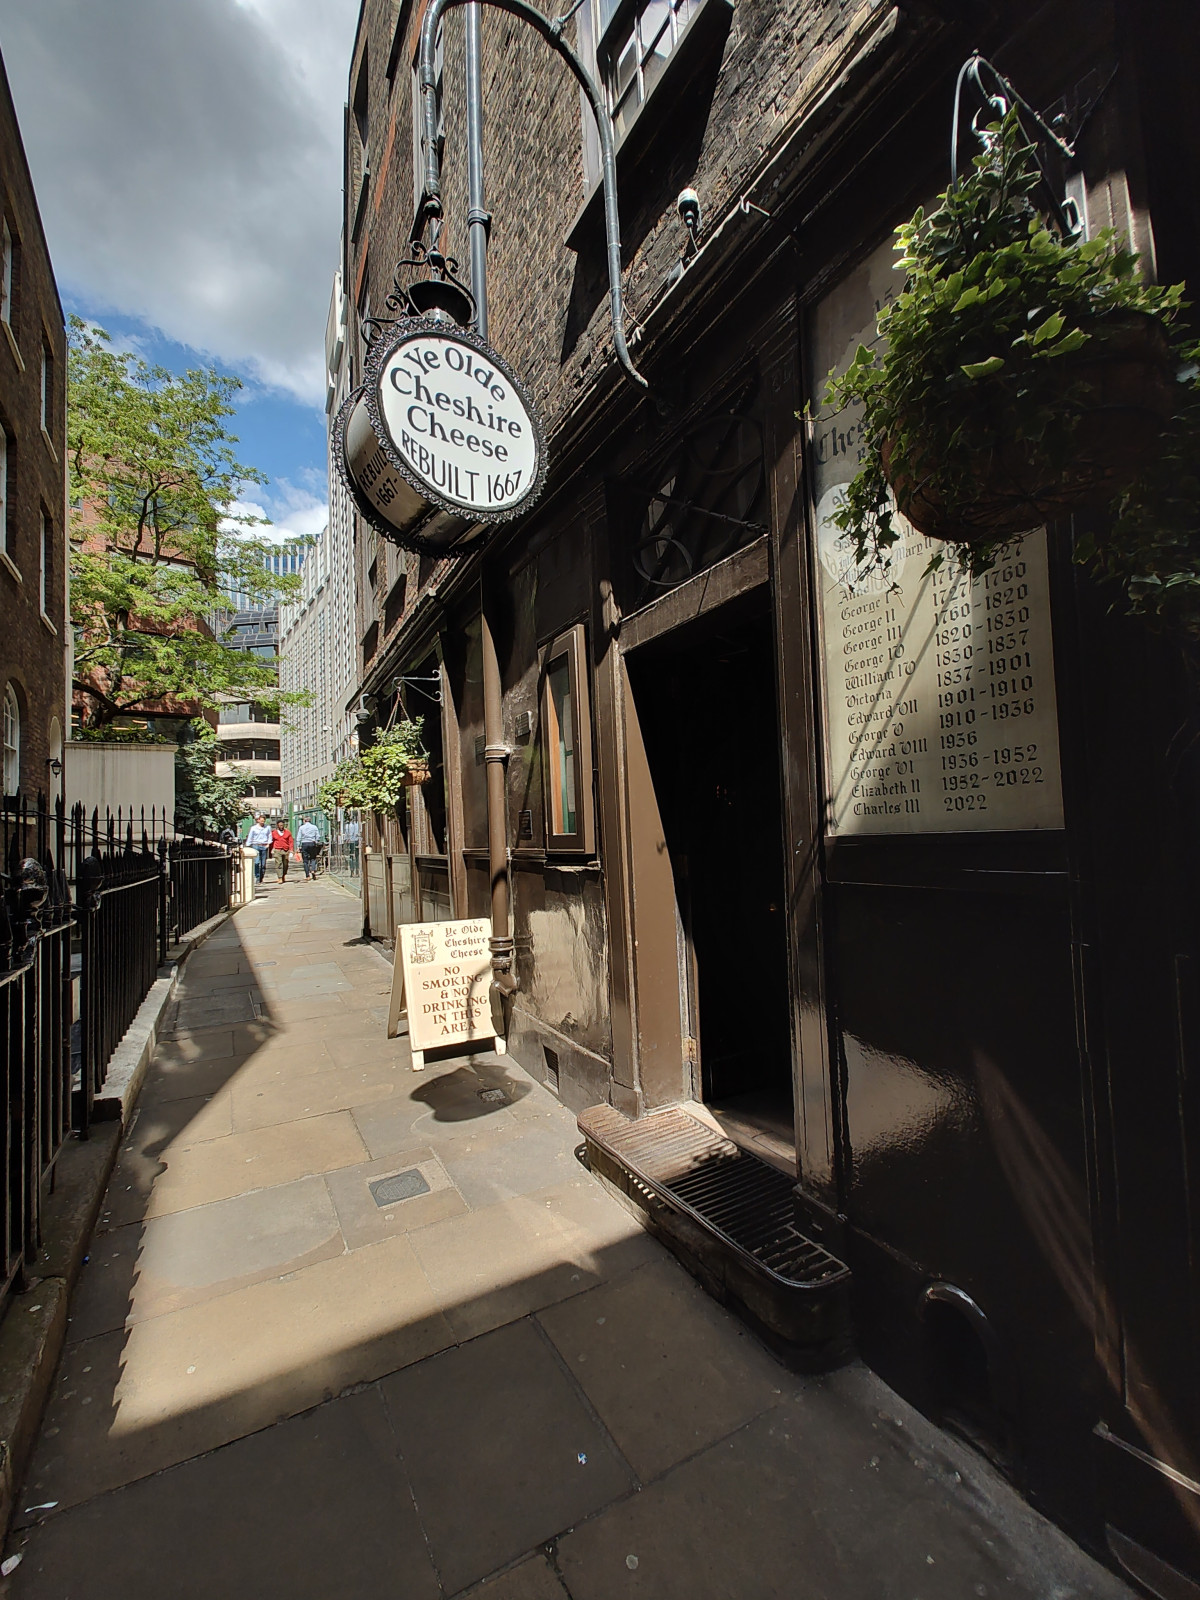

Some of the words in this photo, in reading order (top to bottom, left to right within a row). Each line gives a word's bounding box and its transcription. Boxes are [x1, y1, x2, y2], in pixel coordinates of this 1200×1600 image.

[403, 347, 441, 375] Ye
[444, 347, 506, 402] Olde
[390, 367, 522, 439] Cheshire
[407, 405, 509, 463] Cheese
[401, 429, 480, 502] REBUILT
[487, 470, 523, 503] 1667
[841, 599, 881, 621] George
[842, 616, 883, 639] George
[885, 608, 896, 623] II
[843, 635, 883, 655] George
[886, 625, 902, 642] III
[844, 653, 884, 673] George
[888, 643, 905, 661] IV
[845, 670, 895, 691] William
[897, 660, 916, 677] IV
[845, 690, 893, 708] Victoria
[847, 704, 894, 726] Edward
[895, 699, 918, 716] VII
[848, 728, 889, 745] George
[891, 722, 904, 737] V
[849, 743, 897, 762] Edward
[898, 737, 928, 755] VIII
[940, 730, 978, 750] 1936
[850, 766, 891, 781] George
[895, 760, 914, 775] VI
[851, 781, 907, 798] Elizabeth
[911, 778, 921, 793] II
[853, 800, 902, 816] Charles
[905, 798, 920, 813] III
[943, 794, 988, 812] 2022
[444, 936, 487, 948] Cheshire
[445, 927, 457, 938] Ye
[461, 924, 484, 934] Olde
[450, 948, 484, 959] Cheese
[422, 973, 483, 990] SMOKING
[444, 966, 461, 976] NO
[440, 989, 449, 999] &
[454, 987, 470, 997] NO
[422, 995, 488, 1014] DRINKING
[433, 1013, 447, 1025] IN
[452, 1007, 482, 1021] THIS
[440, 1020, 478, 1036] AREA
